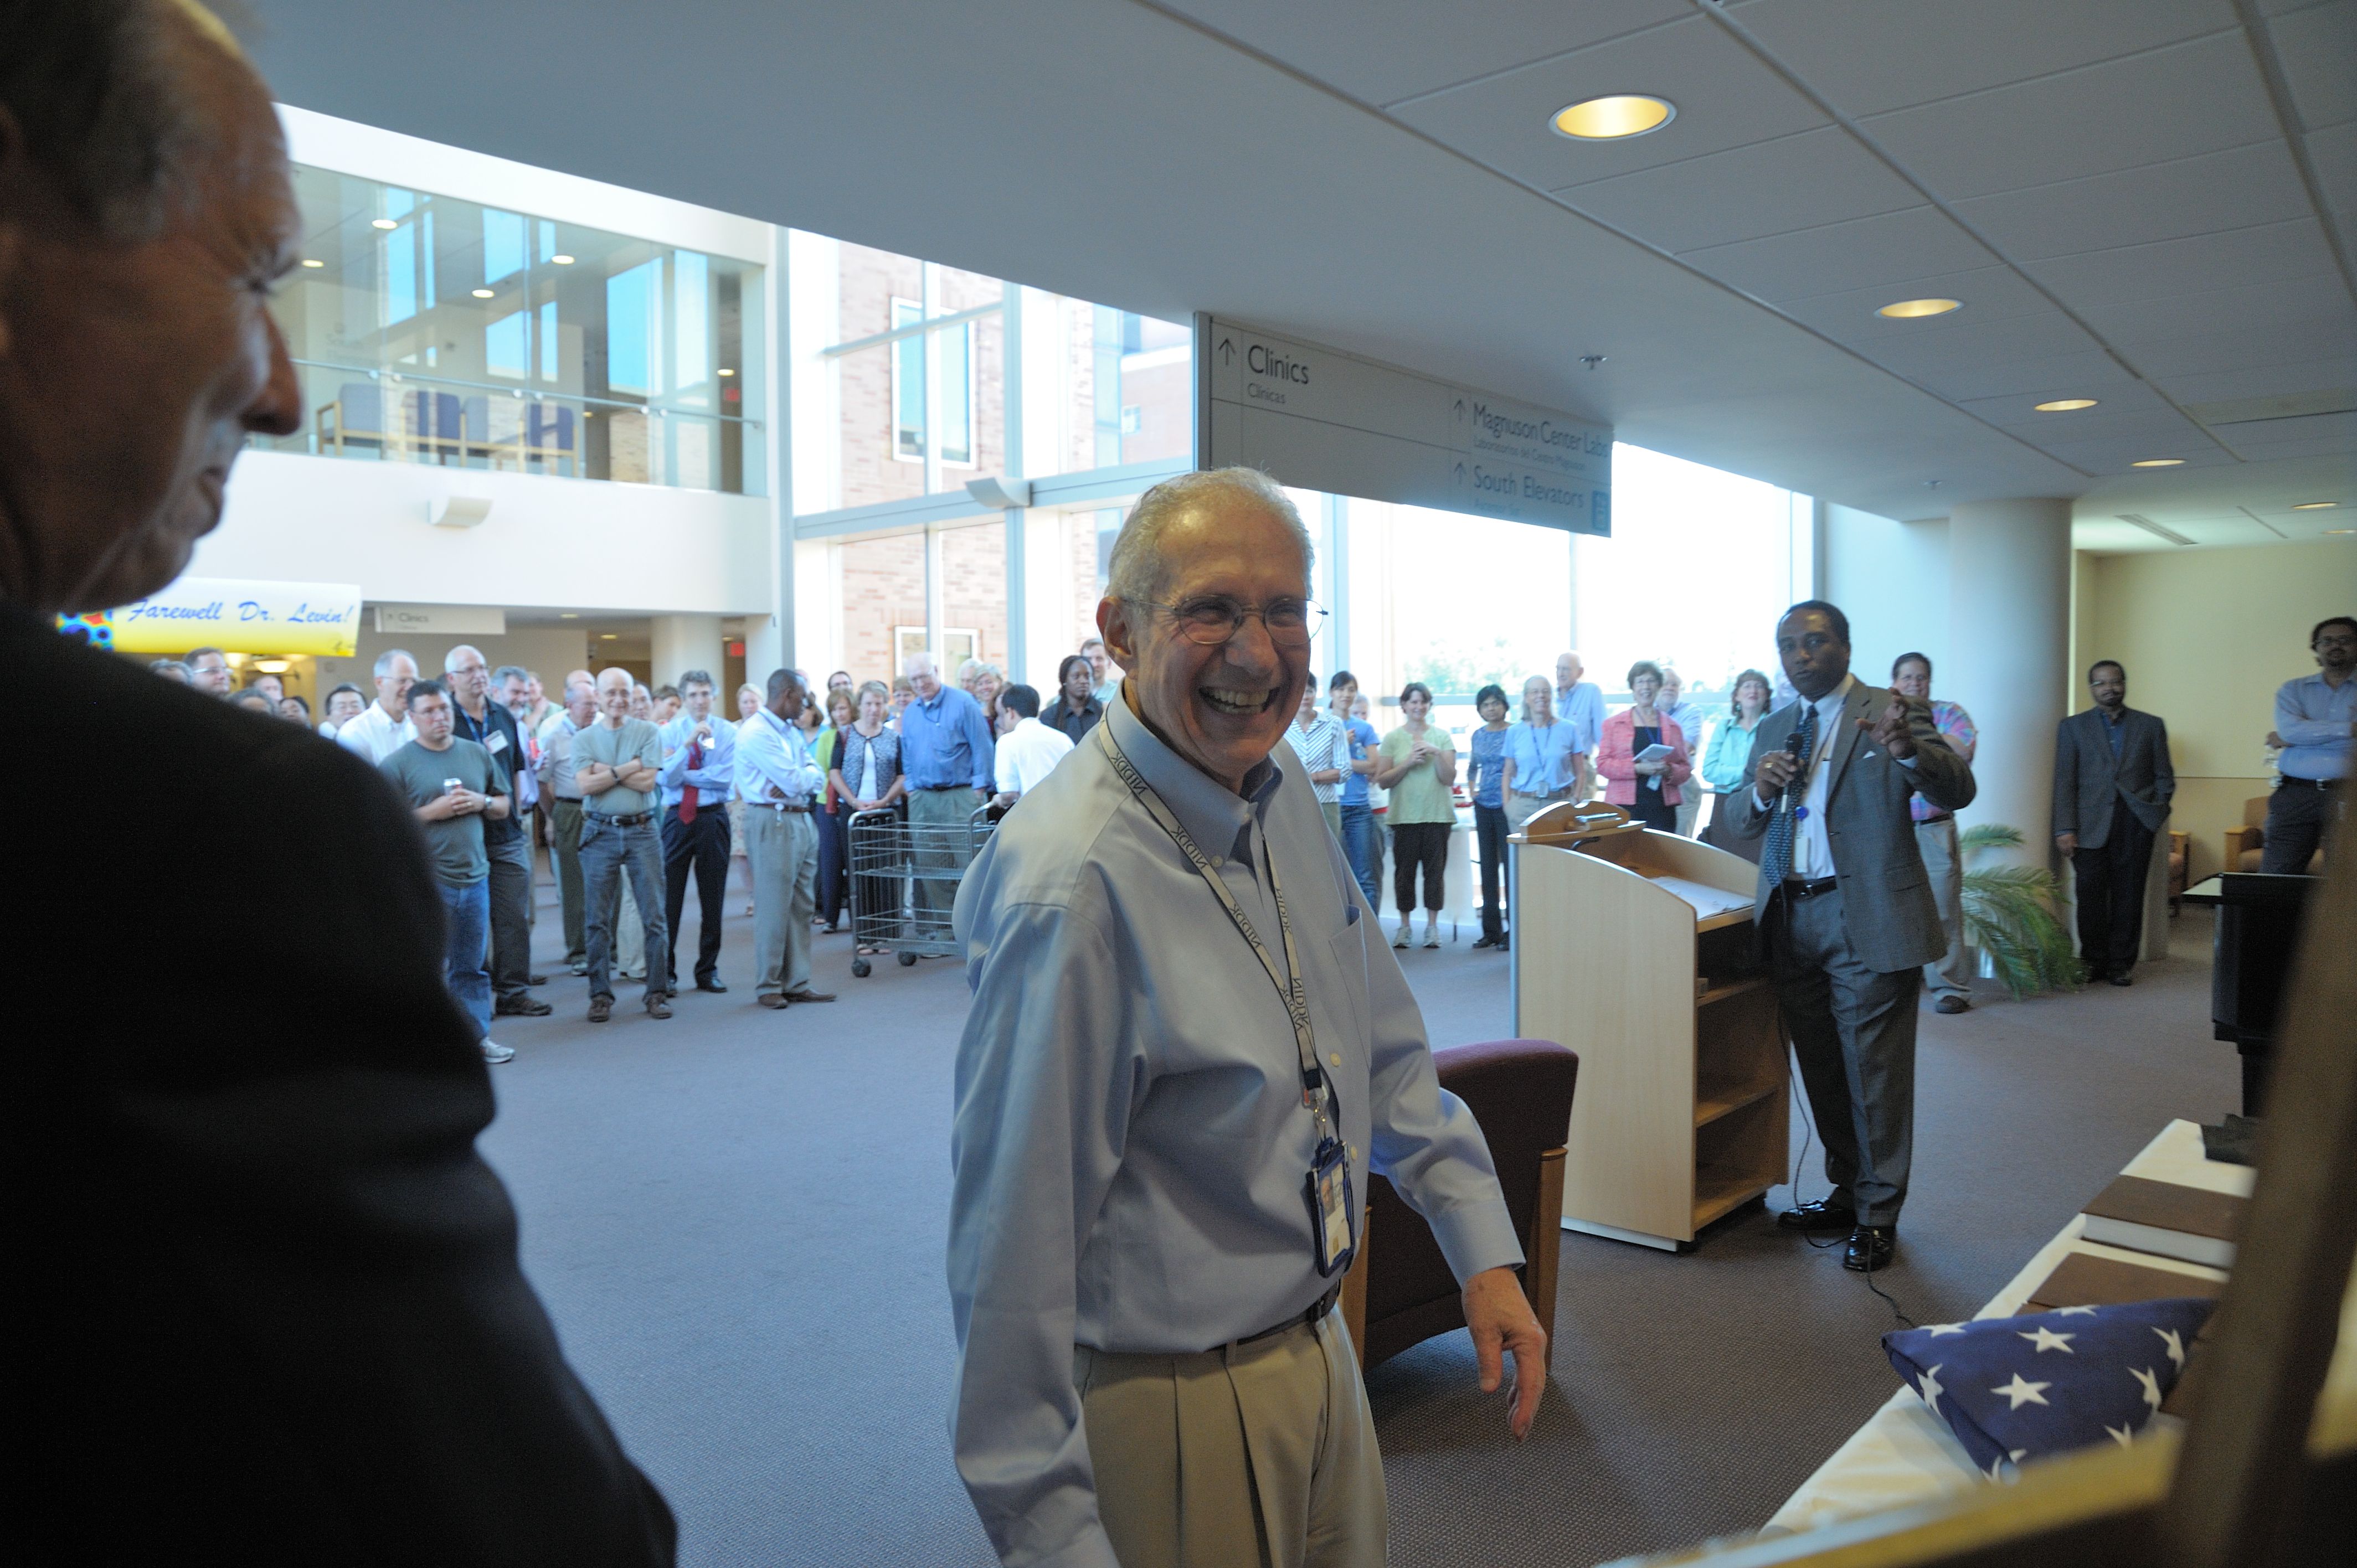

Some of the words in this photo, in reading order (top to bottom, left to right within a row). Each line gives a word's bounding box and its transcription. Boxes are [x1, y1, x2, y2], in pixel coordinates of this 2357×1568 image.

[1248, 345, 1309, 384] Clinics
[1474, 402, 1538, 439] Magnuson
[1541, 421, 1581, 451] Center
[1474, 465, 1516, 495] South
[1524, 476, 1583, 508] Elevators
[127, 599, 222, 622] Farewell
[239, 601, 275, 621] Dr.
[287, 603, 354, 623] Levin!
[1111, 751, 1149, 795] NIDDK
[1171, 826, 1208, 869] NIDDK
[1229, 903, 1262, 949] NIDDK
[1277, 888, 1291, 933] NIDDK
[1279, 983, 1303, 1031] NIDDK
[1293, 978, 1309, 1025] NIDDK
